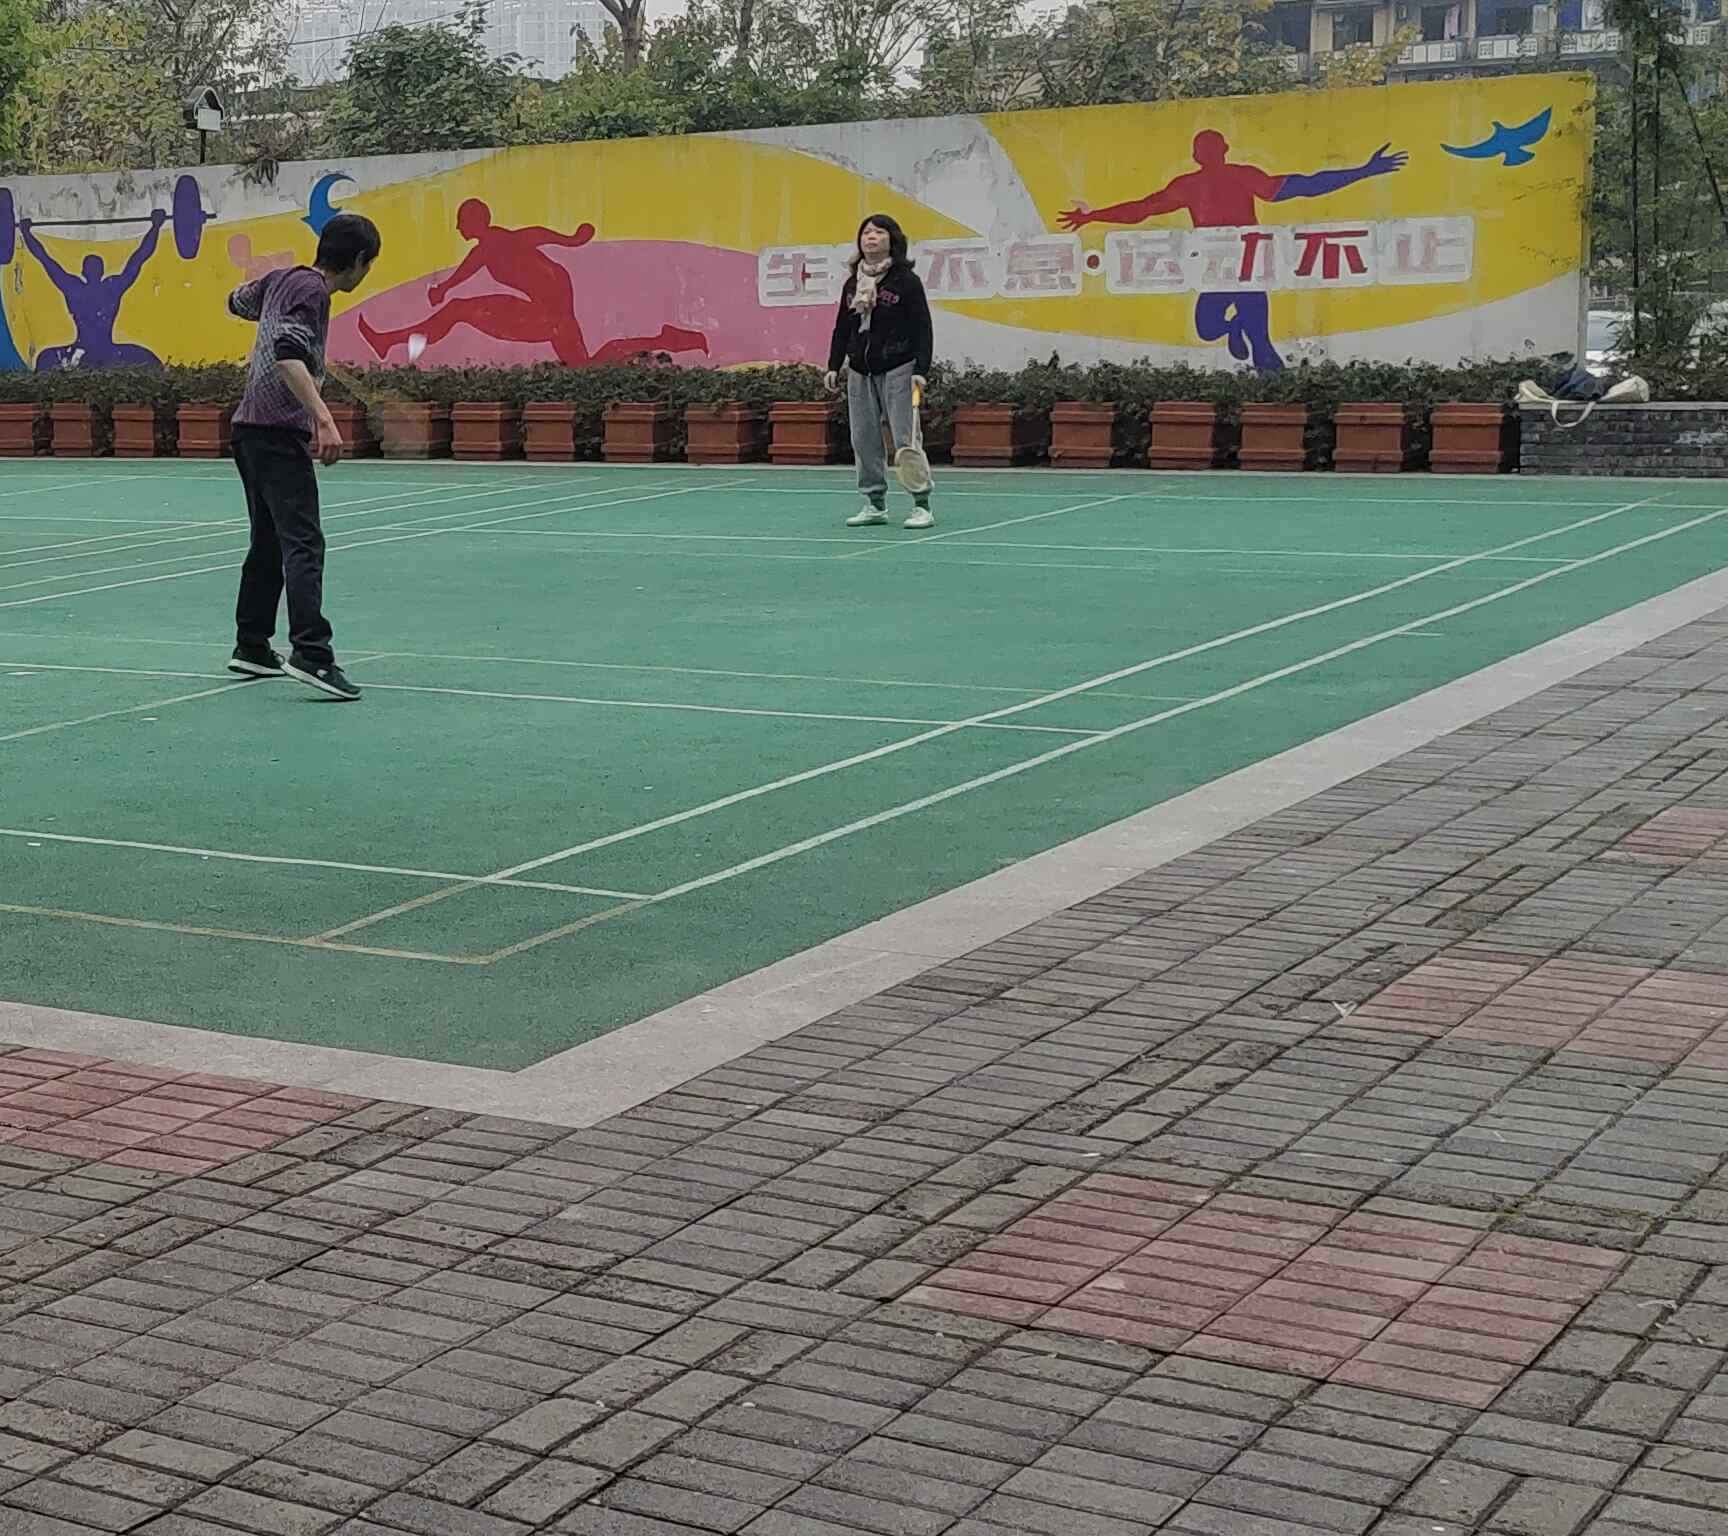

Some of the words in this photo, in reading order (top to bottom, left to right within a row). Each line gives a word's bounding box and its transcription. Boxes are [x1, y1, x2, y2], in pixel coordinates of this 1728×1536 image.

[766, 226, 1467, 297] 生不息·运动不止
